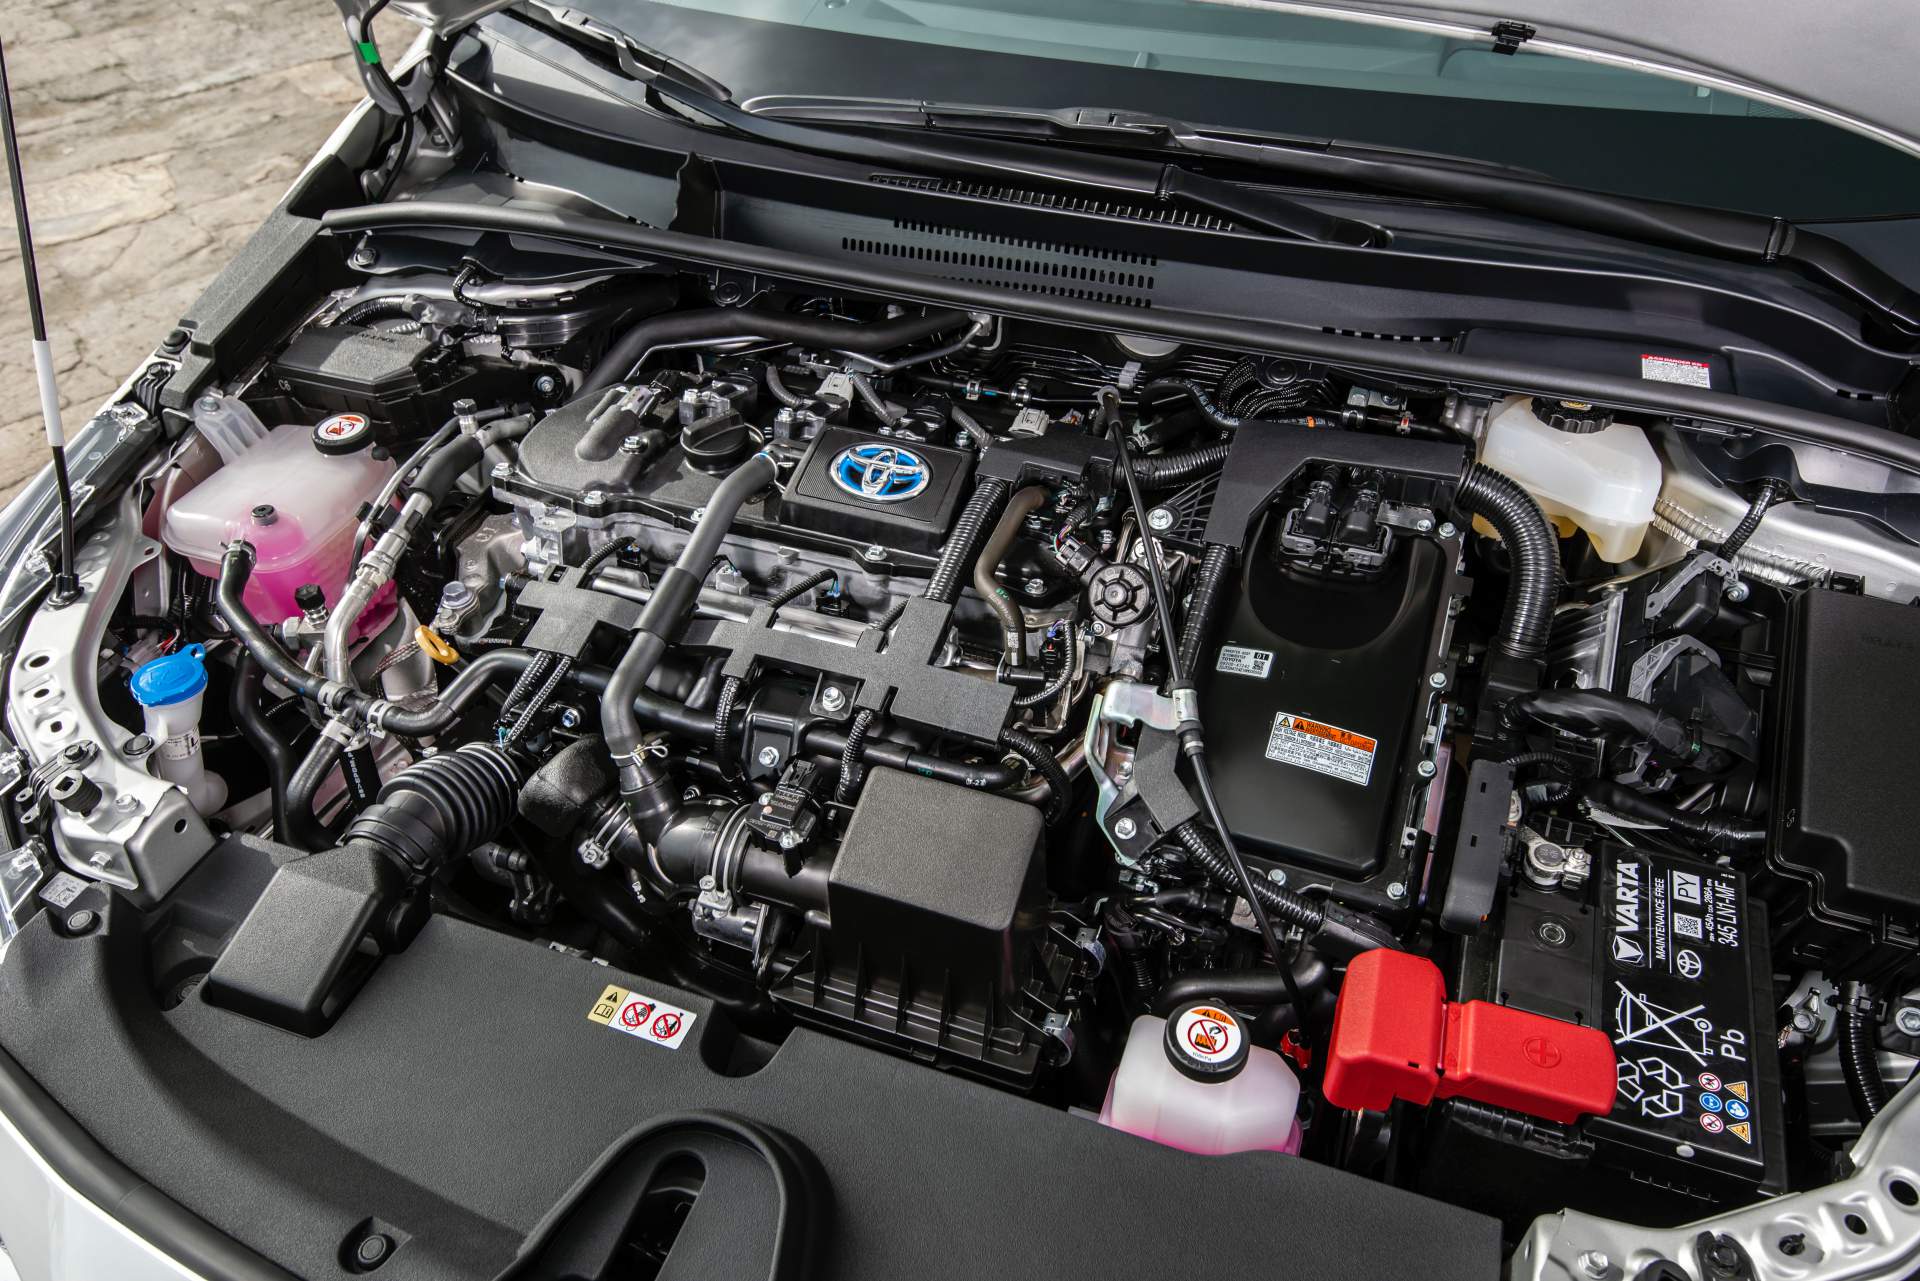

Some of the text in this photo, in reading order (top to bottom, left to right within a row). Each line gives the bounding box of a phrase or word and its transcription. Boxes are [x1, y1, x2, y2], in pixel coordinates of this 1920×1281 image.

[1615, 861, 1640, 932] VARTA
[1677, 873, 1697, 899] PY
[1714, 879, 1737, 924] LN1-MF
[1655, 876, 1666, 959] MAINTENANCE FREE
[1704, 912, 1714, 931] 45Ah
[1717, 922, 1739, 946] 345
[1720, 1028, 1747, 1062] Pb
